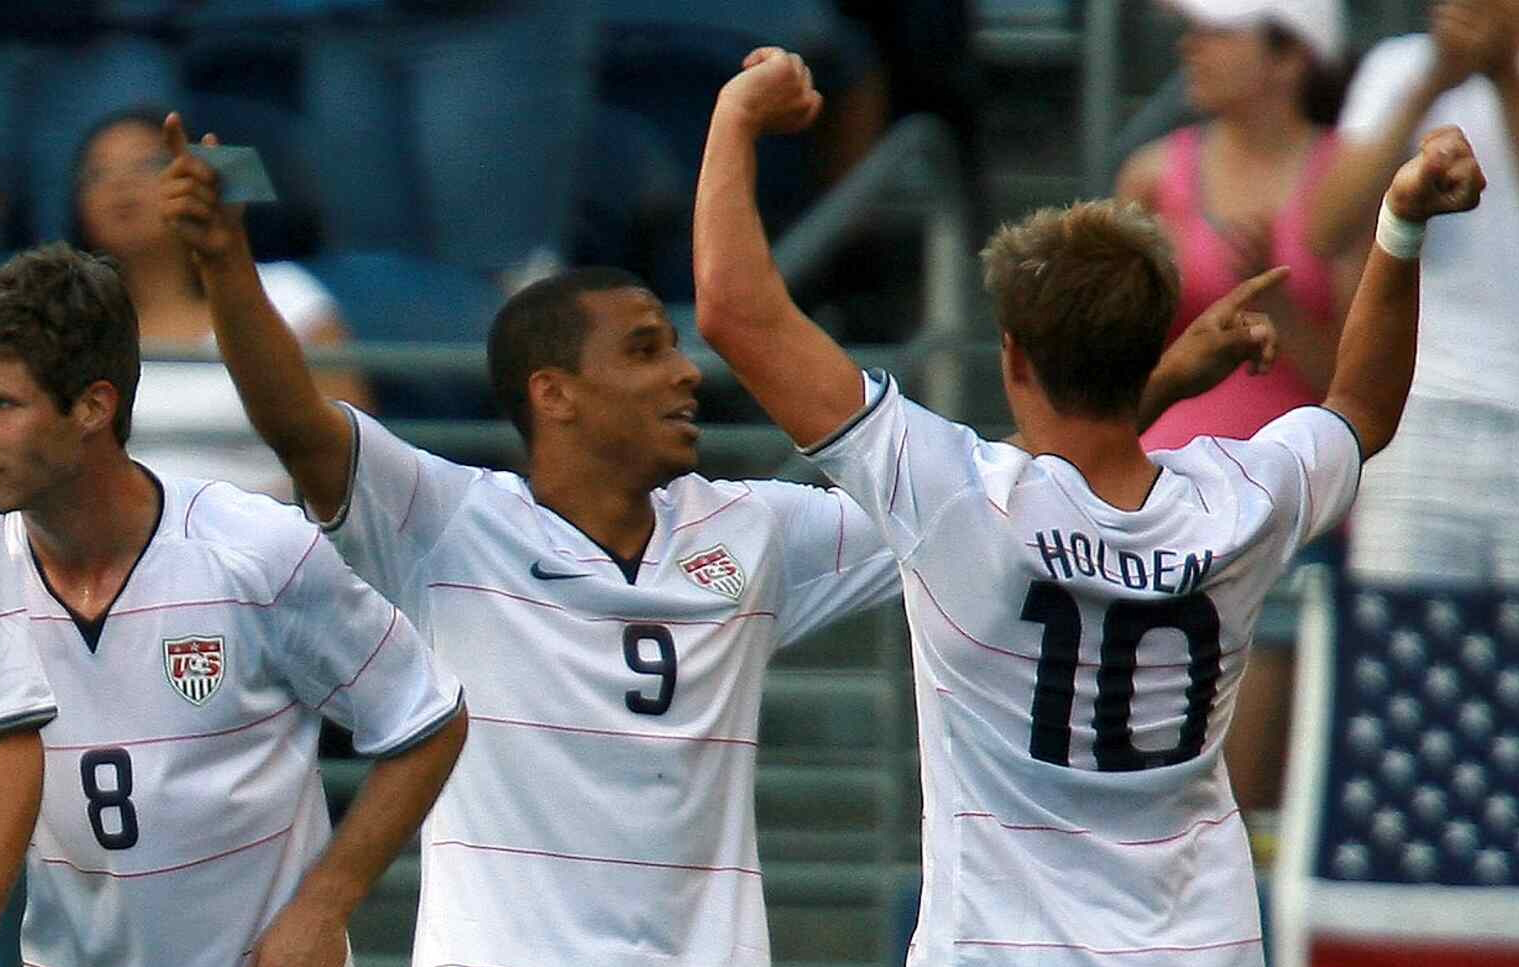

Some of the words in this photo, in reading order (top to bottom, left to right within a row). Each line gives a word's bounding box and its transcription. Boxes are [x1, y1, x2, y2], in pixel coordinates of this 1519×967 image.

[1035, 528, 1214, 594] HOLDEN
[622, 622, 678, 718] 9
[1021, 578, 1222, 774] 10
[80, 747, 139, 851] 8
